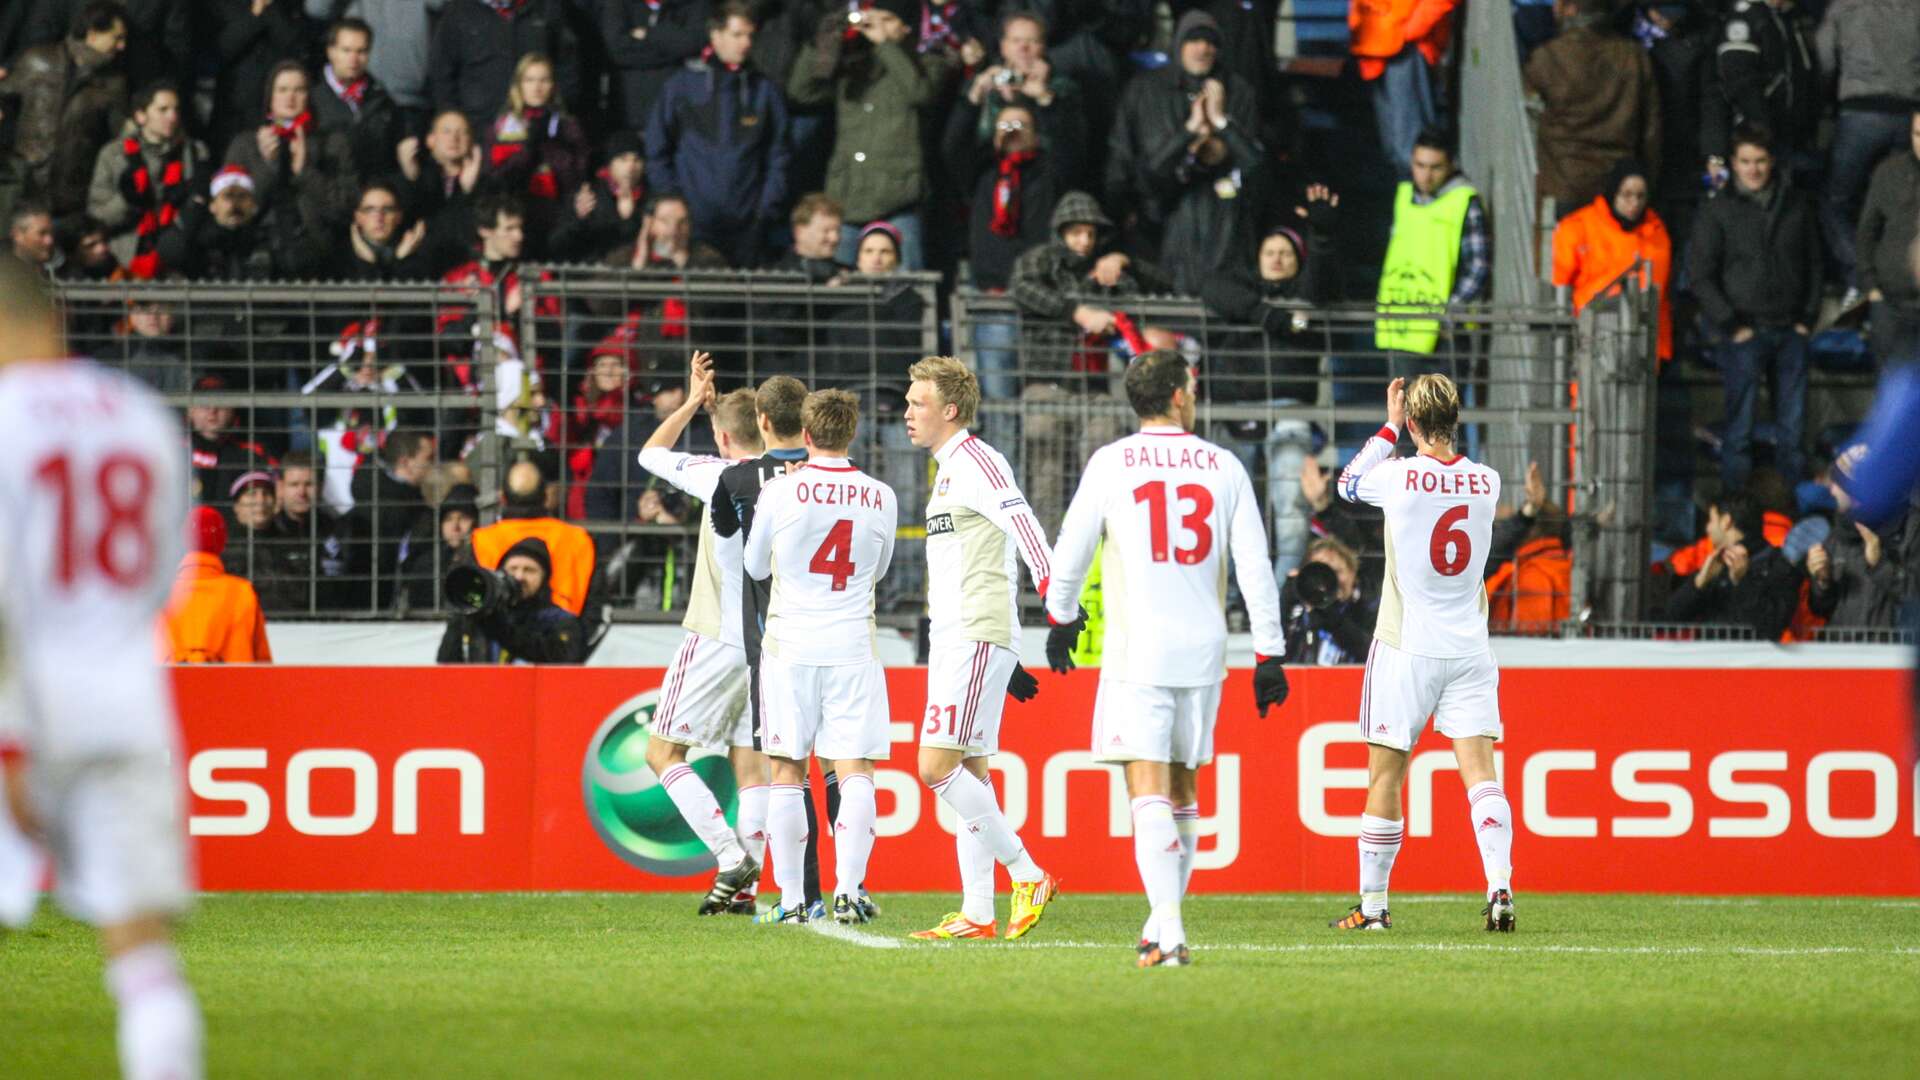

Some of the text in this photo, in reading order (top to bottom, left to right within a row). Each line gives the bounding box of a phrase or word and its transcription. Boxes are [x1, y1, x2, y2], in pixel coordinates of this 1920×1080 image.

[1123, 446, 1220, 470] BALLACK
[1405, 469, 1492, 495] ROLFES
[35, 452, 154, 590] 18
[796, 482, 883, 511] OCZIPKA
[1132, 480, 1215, 565] 13
[927, 516, 953, 533] OWER
[1429, 504, 1472, 576] 6
[809, 519, 856, 591] 4
[926, 704, 957, 736] 31
[189, 748, 486, 836] son
